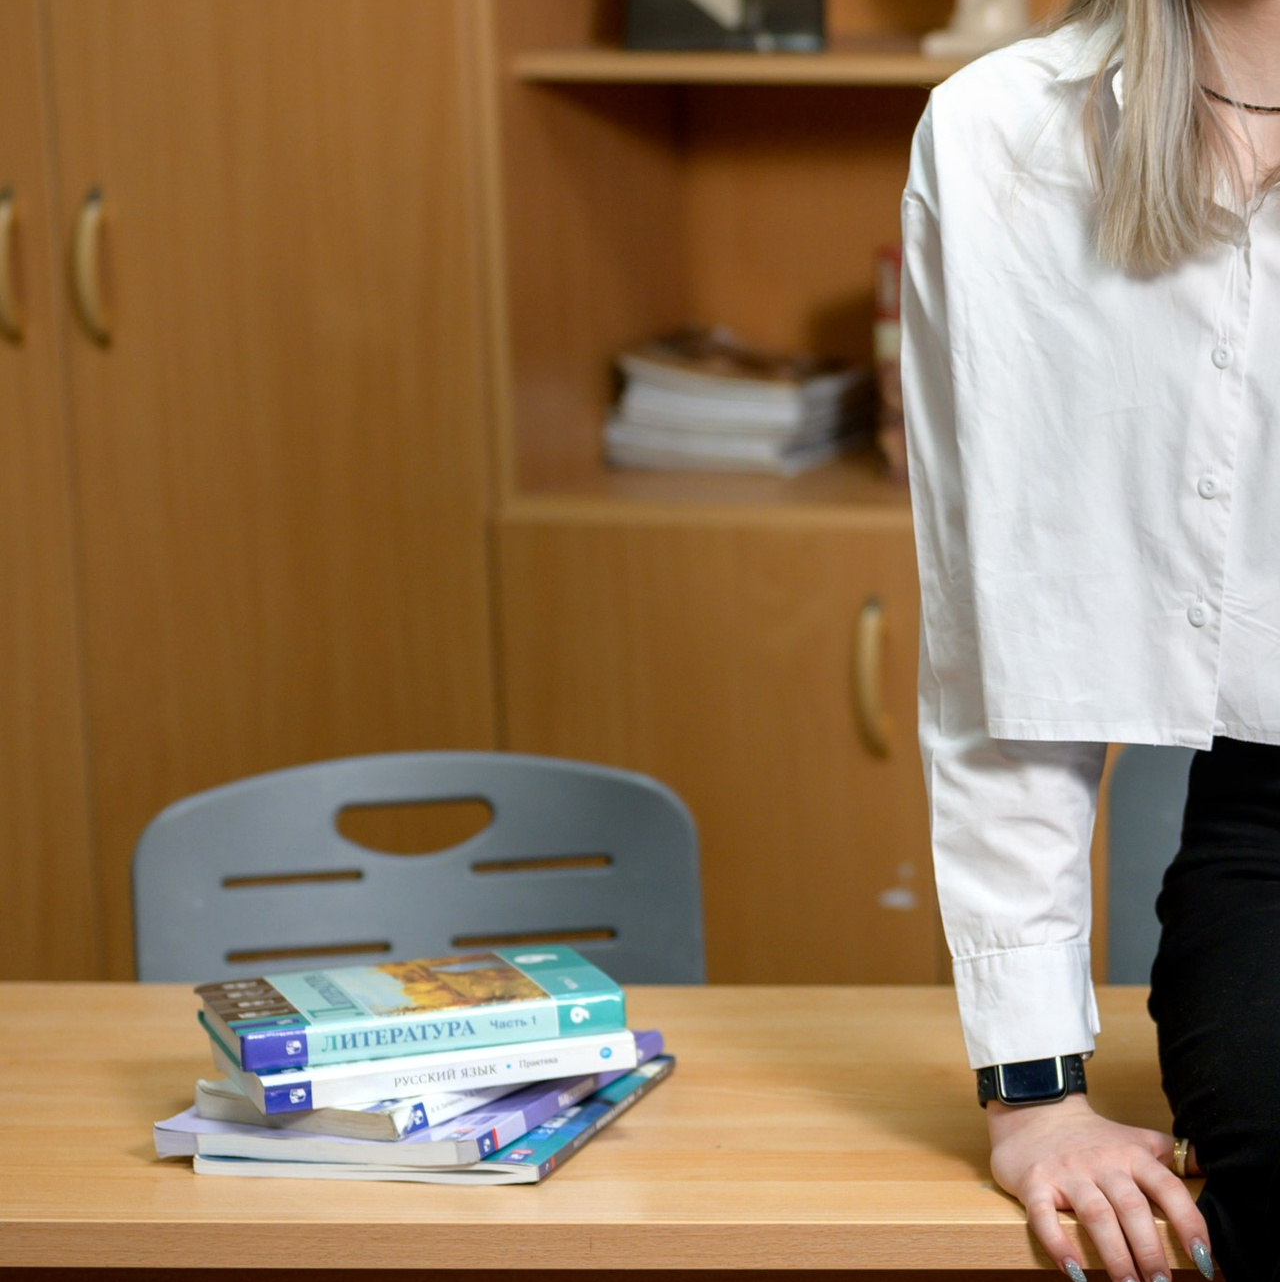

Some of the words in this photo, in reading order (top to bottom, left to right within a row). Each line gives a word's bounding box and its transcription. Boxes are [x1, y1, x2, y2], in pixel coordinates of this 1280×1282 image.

[570, 1006, 590, 1024] 9
[321, 1019, 476, 1053] ЛИТЕРАТУРА
[490, 1019, 527, 1031] Часть
[532, 1014, 537, 1026] 1
[394, 1069, 457, 1088] РУССКИЙ
[460, 1063, 498, 1079] ЯЗЫК
[519, 1057, 559, 1069] Практика
